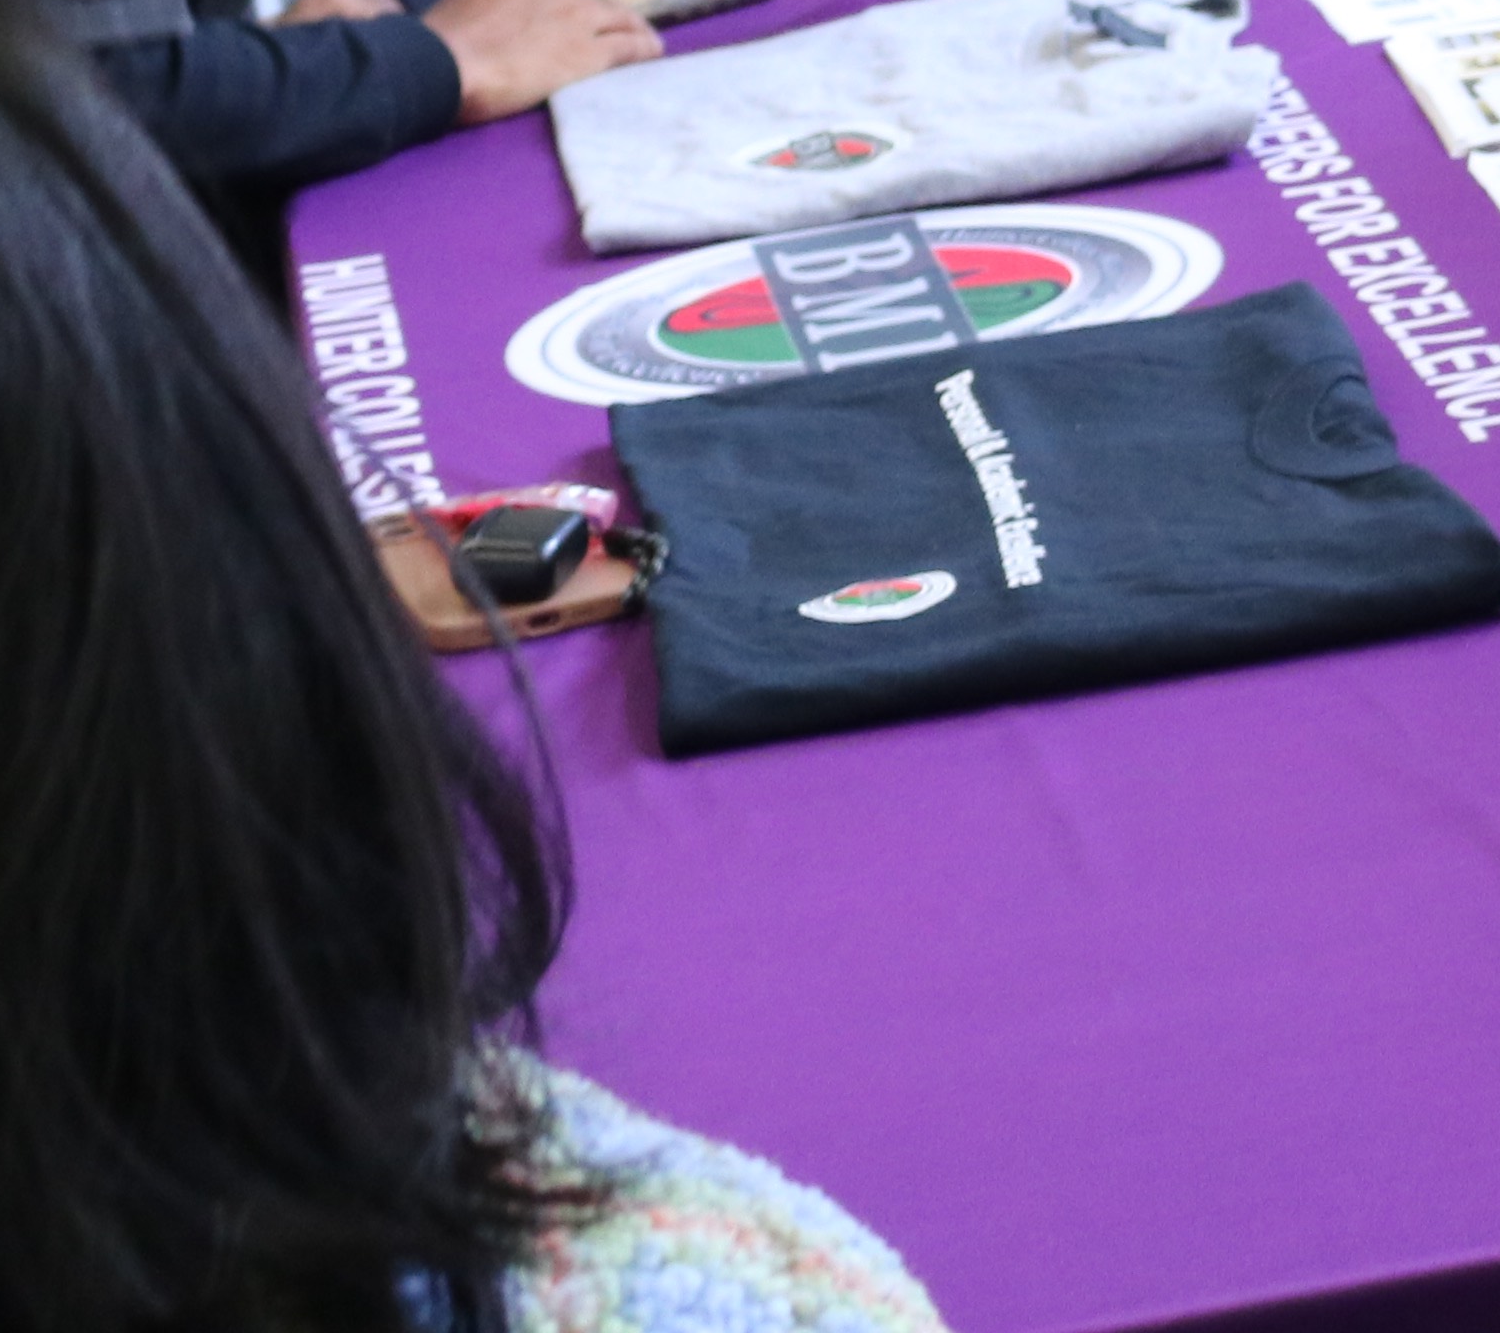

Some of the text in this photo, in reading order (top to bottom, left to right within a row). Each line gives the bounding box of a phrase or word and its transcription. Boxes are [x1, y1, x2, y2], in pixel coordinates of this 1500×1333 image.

[1280, 176, 1400, 247] FOR
[300, 252, 408, 382] HUNTER
[771, 232, 959, 372] BMI
